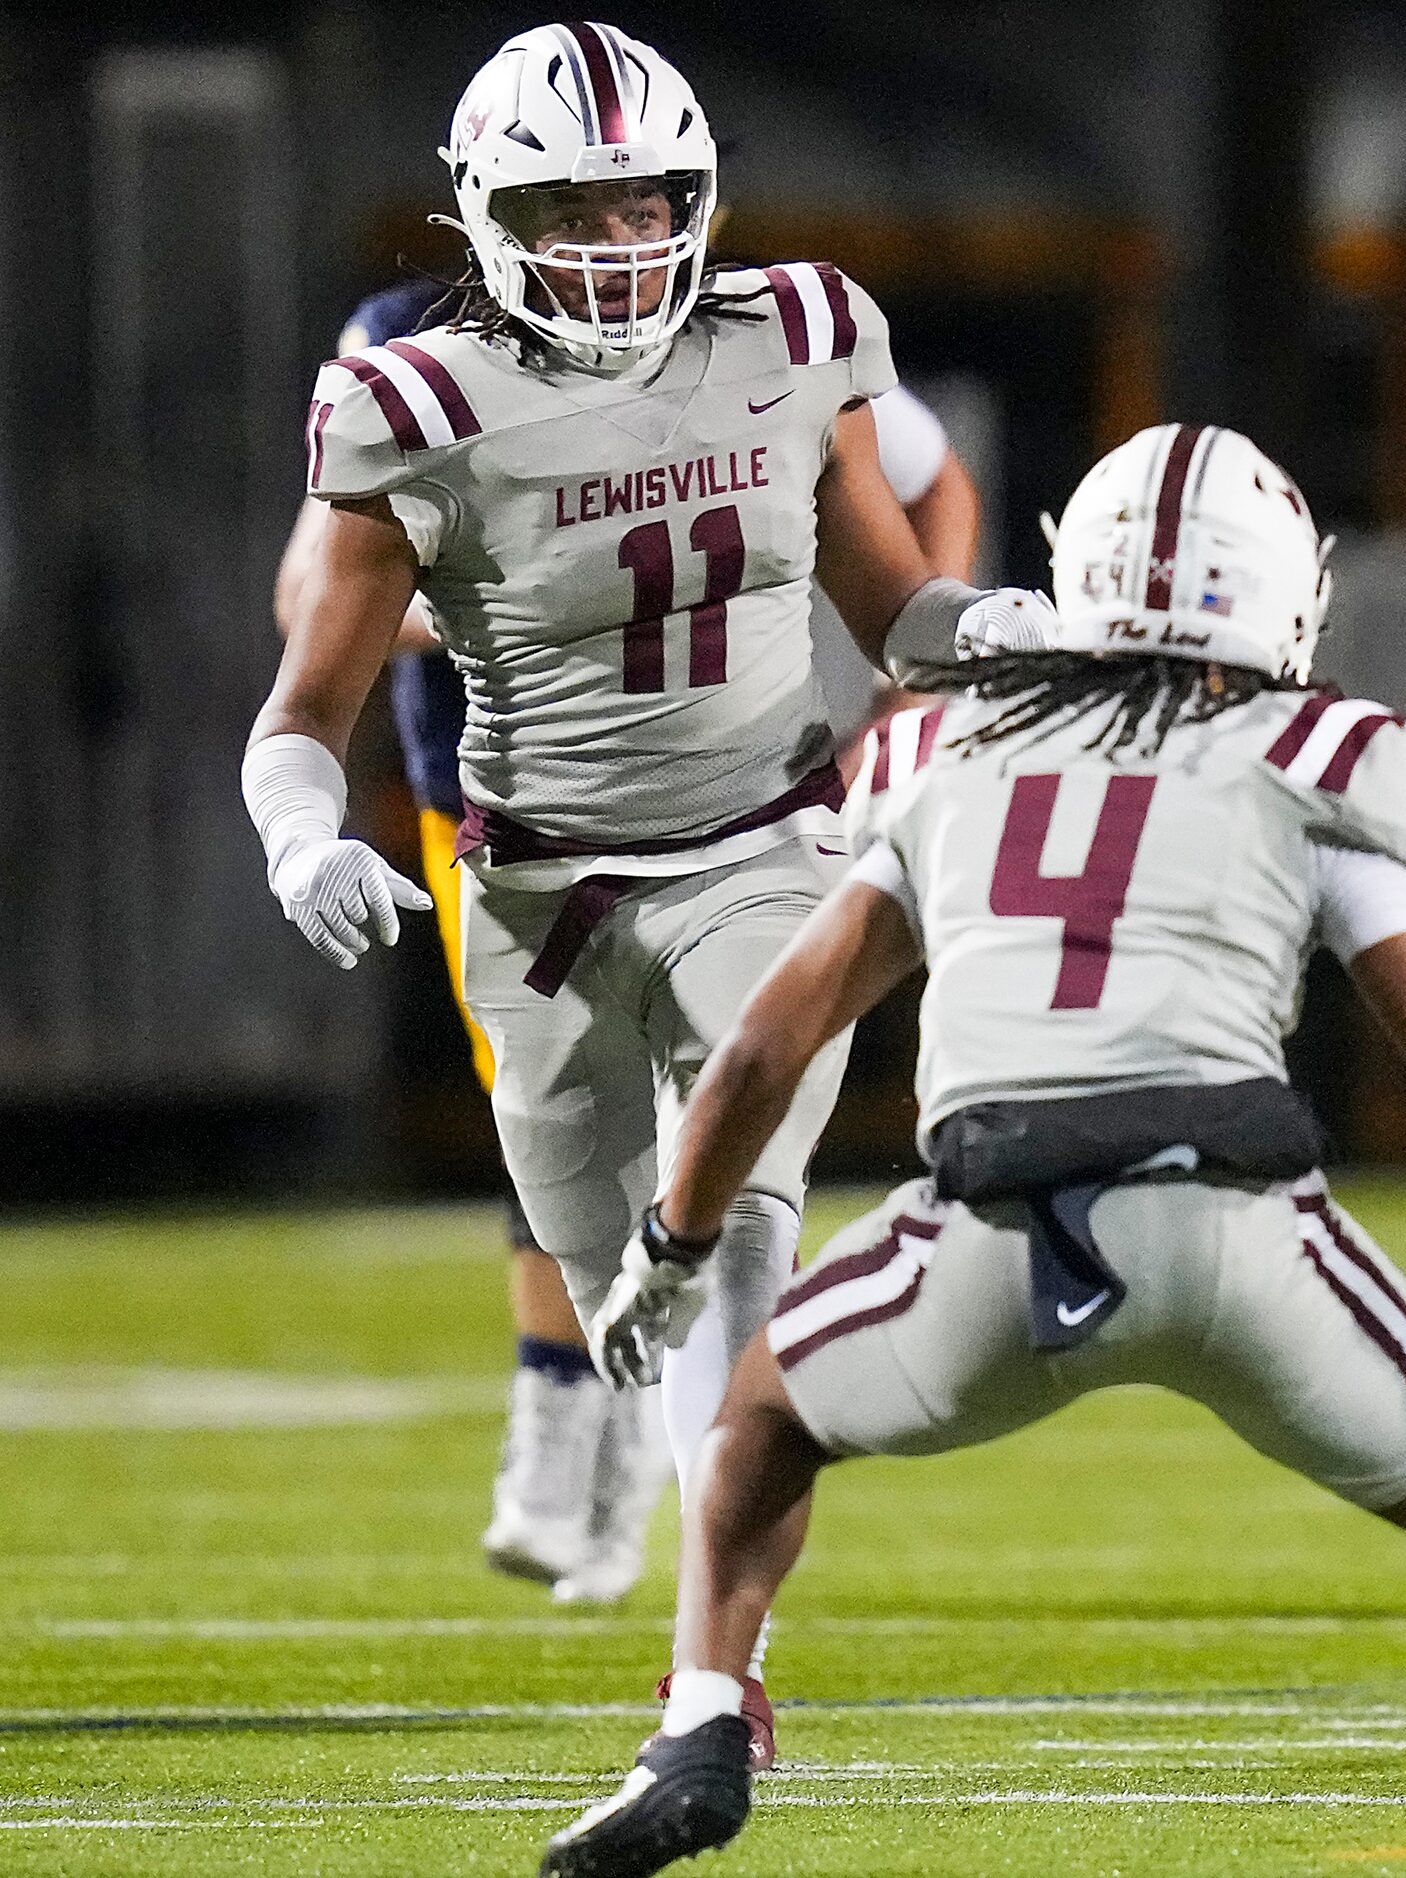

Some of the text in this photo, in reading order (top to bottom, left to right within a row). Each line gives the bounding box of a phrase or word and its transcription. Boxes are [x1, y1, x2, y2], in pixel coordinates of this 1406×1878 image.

[602, 328, 642, 339] Riddll
[556, 446, 769, 528] LEWISVILLE
[618, 504, 746, 694] 11
[989, 773, 1157, 1009] 4
